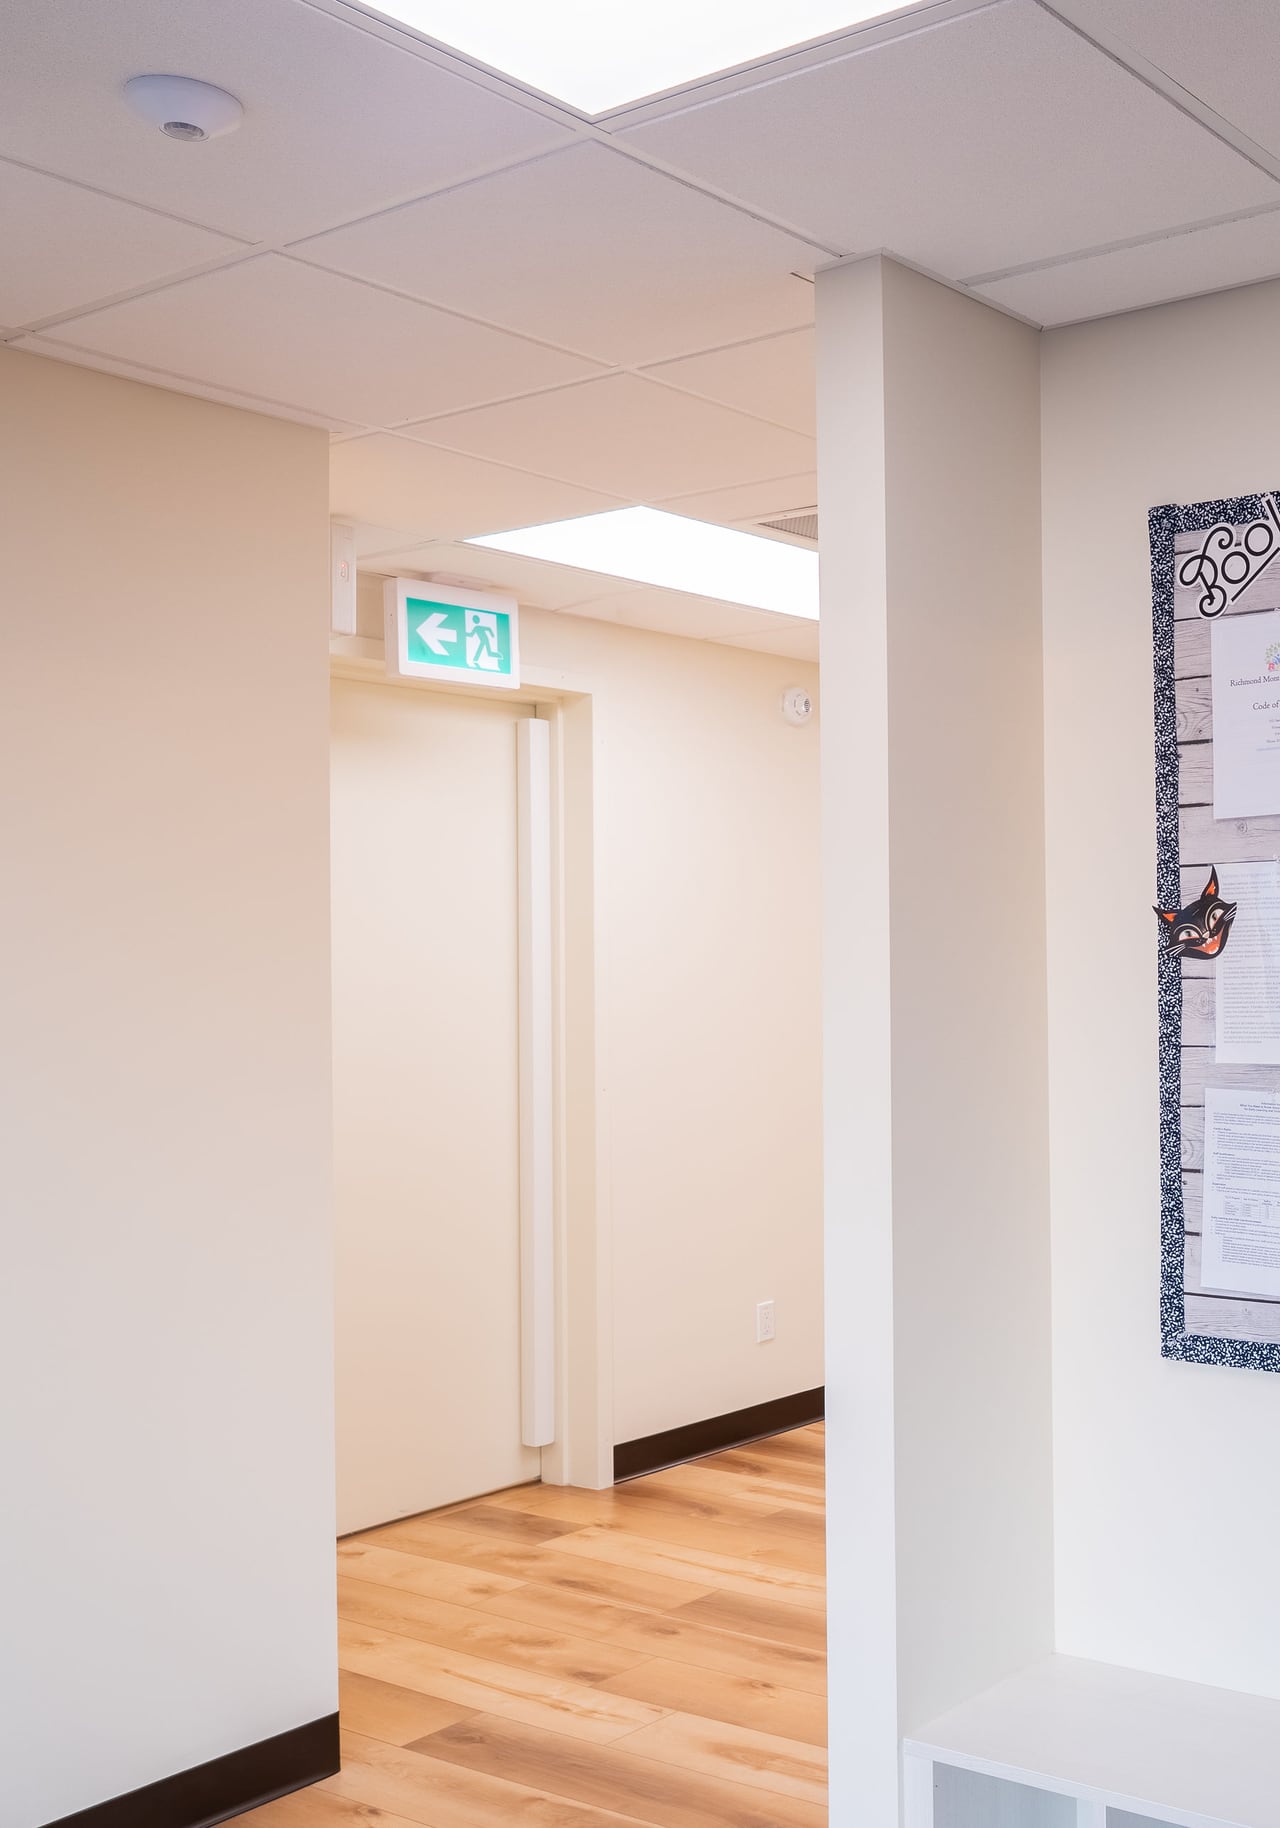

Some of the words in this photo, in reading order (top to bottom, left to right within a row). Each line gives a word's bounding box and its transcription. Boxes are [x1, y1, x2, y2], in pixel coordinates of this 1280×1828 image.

[1230, 675, 1262, 687] Richmond
[1252, 700, 1271, 711] Code
[1271, 700, 1280, 709] of
